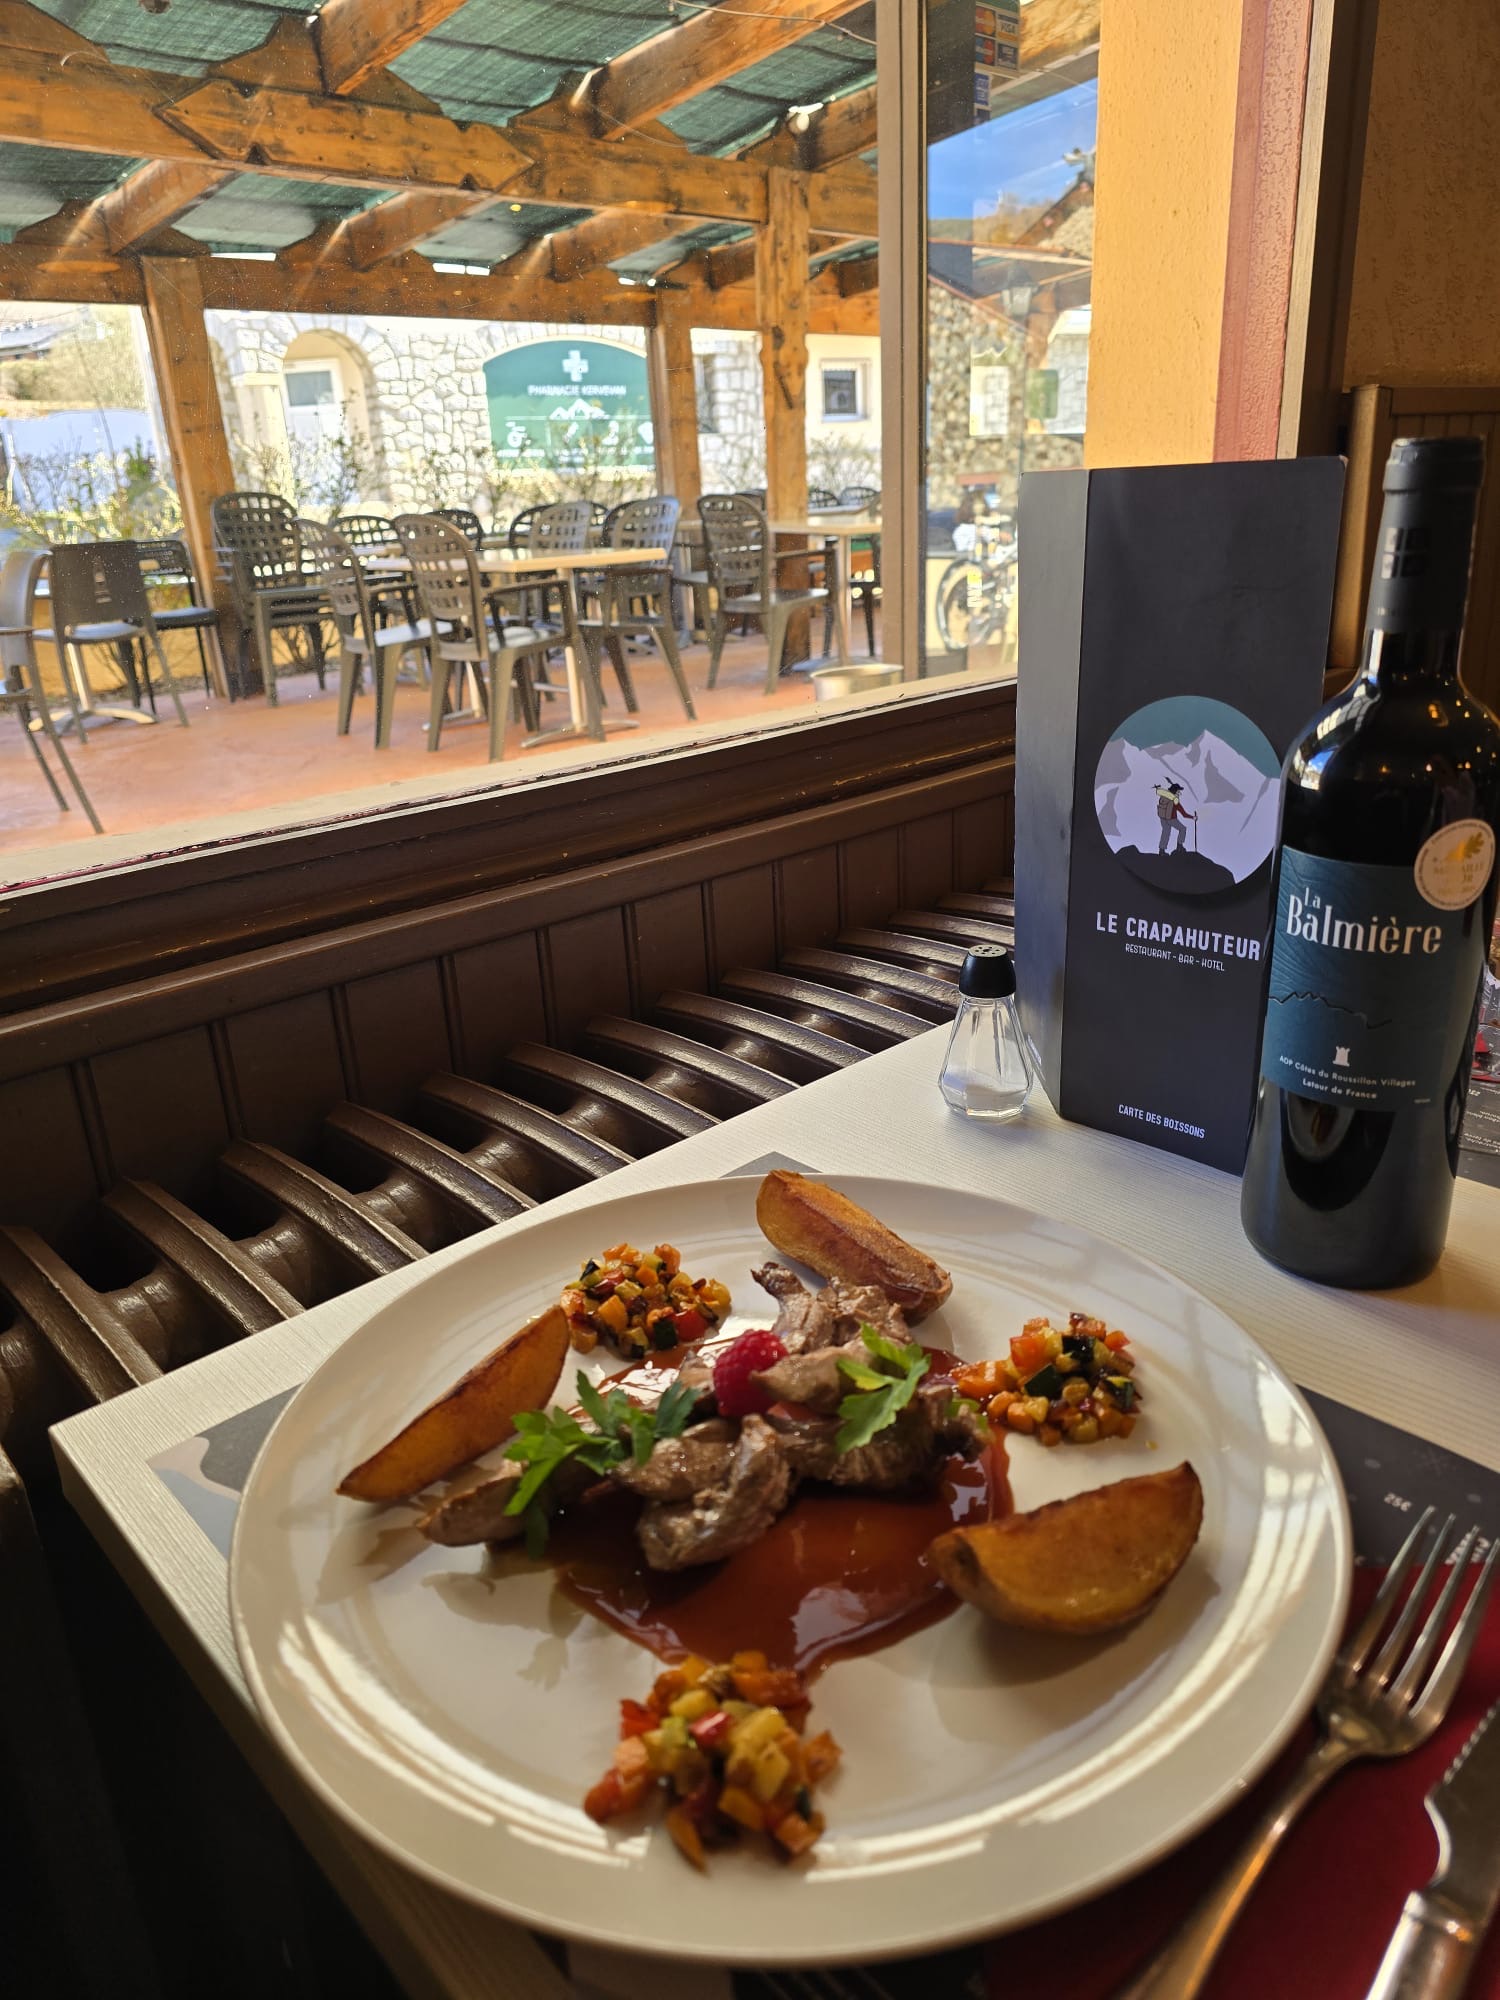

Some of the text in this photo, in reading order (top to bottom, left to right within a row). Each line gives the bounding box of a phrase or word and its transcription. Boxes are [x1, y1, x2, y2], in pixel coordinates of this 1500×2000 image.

[1096, 911, 1261, 961] LE CRAPAHUTEUR
[1286, 894, 1442, 955] Balmière
[1125, 943, 1172, 961] RESTAURANT
[1178, 953, 1194, 966] BAR
[1201, 958, 1225, 972] HOTEL
[1302, 1078, 1377, 1099] Latour de France
[1318, 1069, 1329, 1079] du
[1332, 1072, 1377, 1086] Roussillon
[1380, 1078, 1416, 1088] Villages
[1118, 1104, 1205, 1139] CARTE DES BOISSONS
